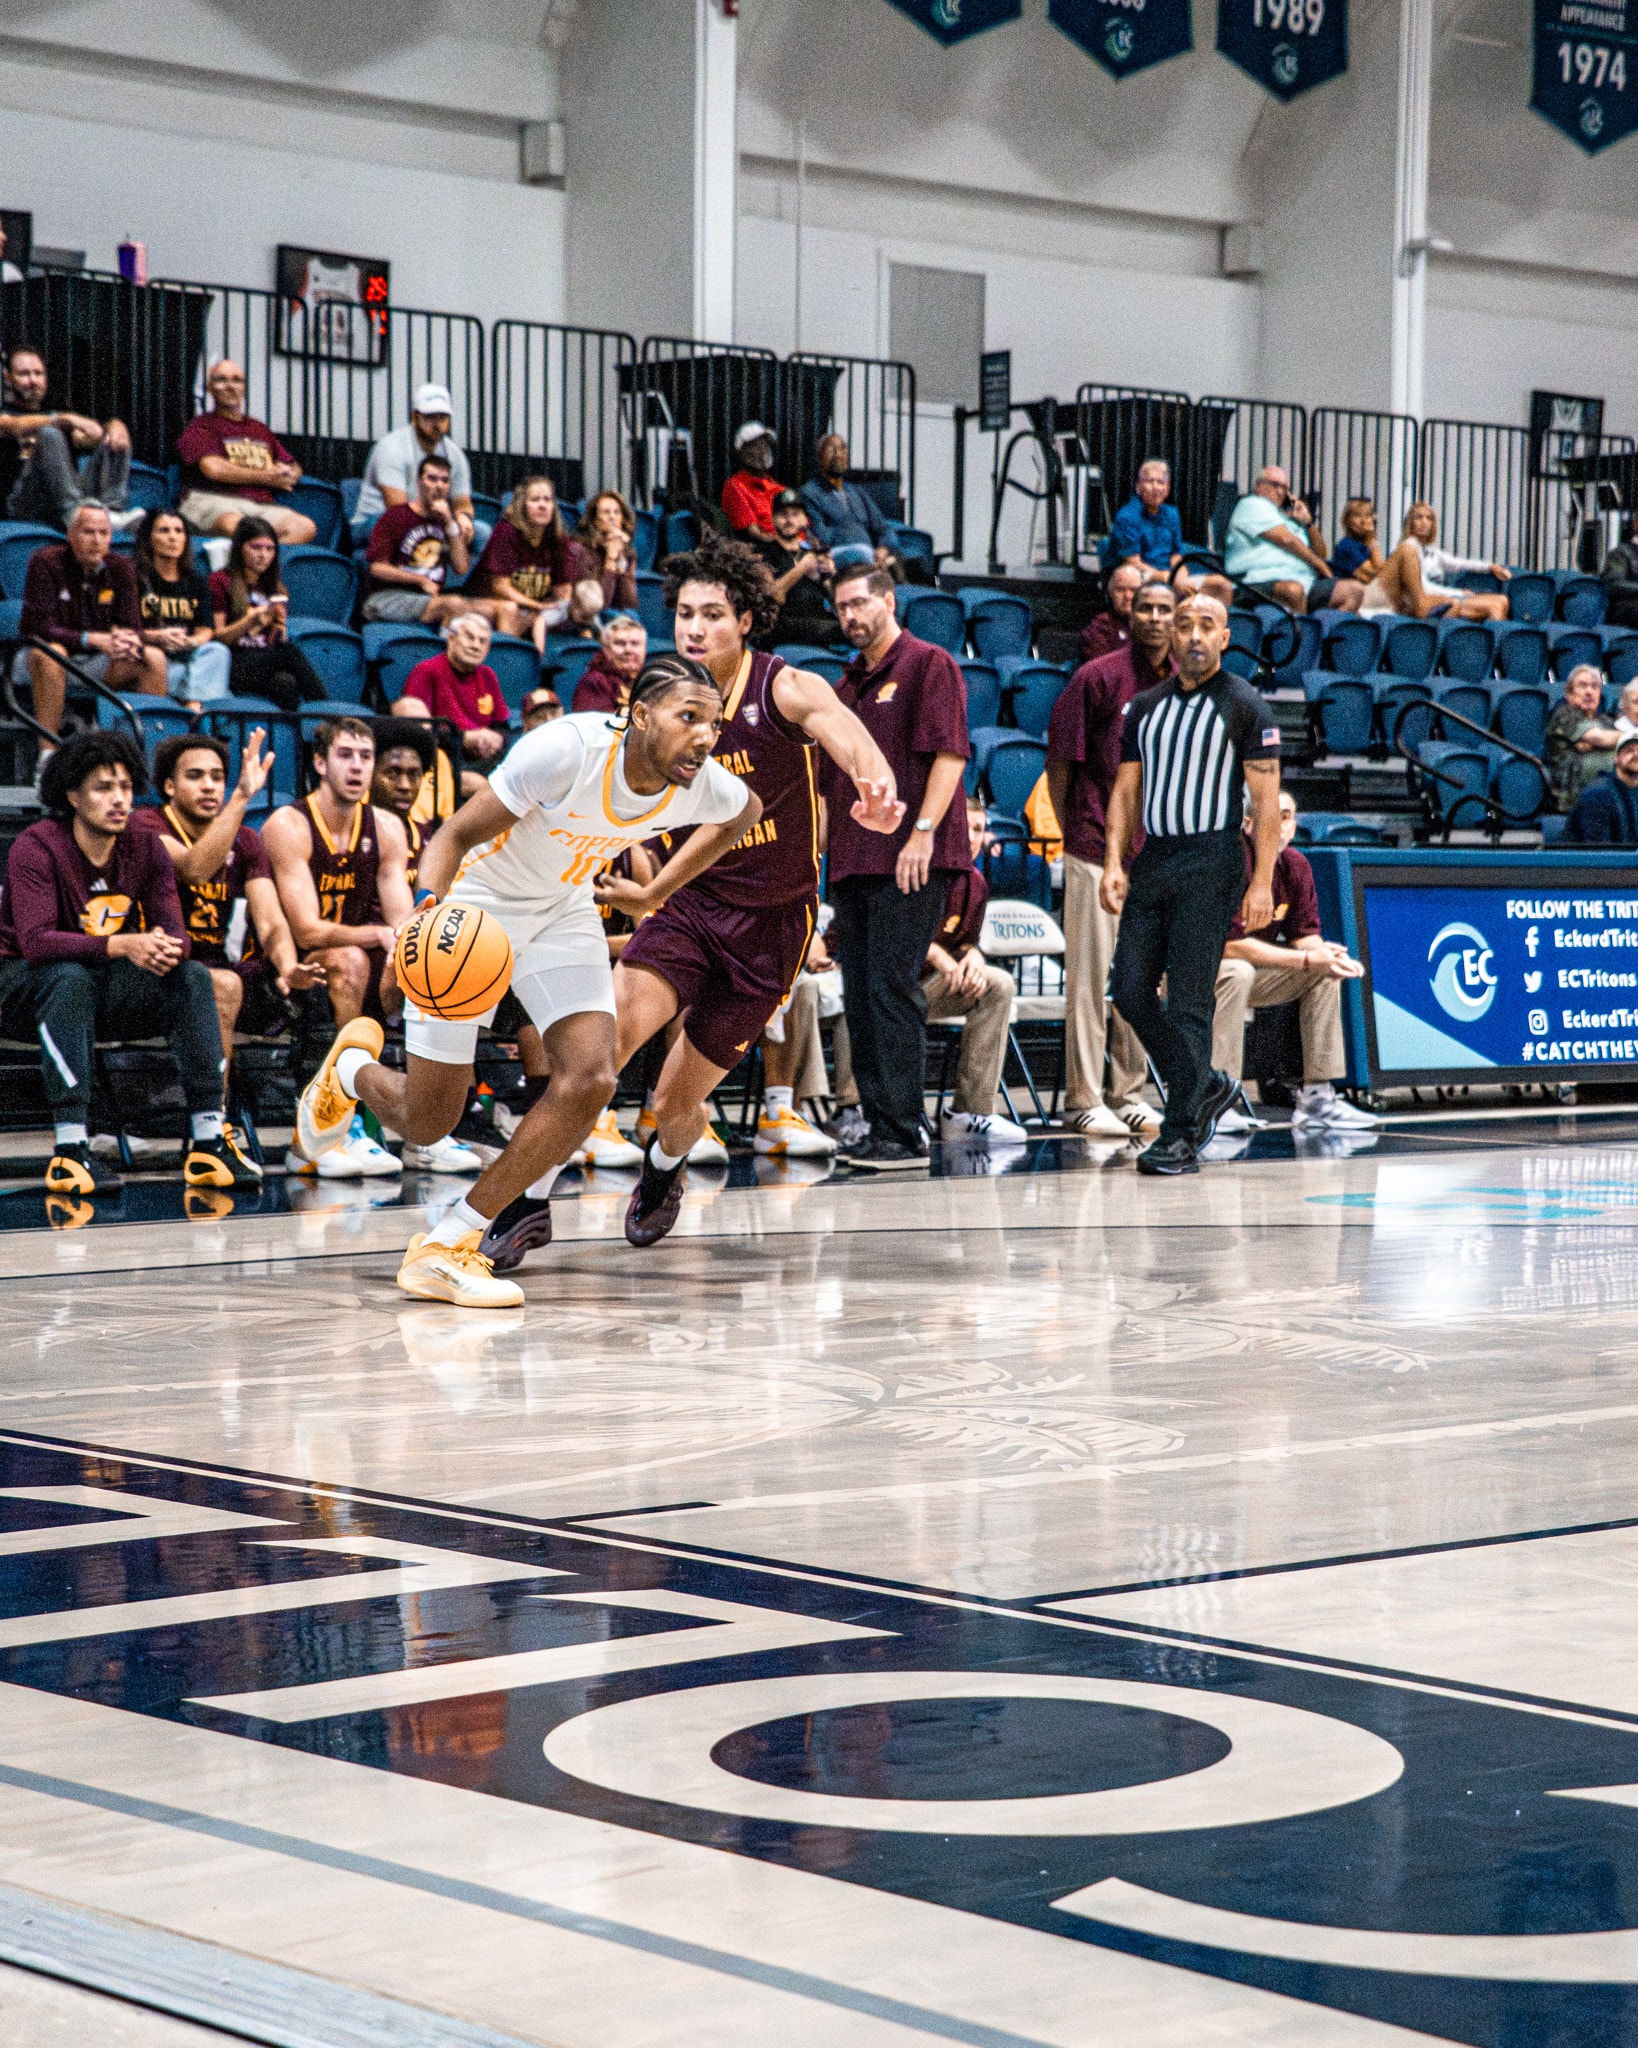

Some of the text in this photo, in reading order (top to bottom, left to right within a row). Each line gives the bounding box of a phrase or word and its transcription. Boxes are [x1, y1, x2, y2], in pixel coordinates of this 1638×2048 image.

[1253, 0, 1324, 36] 1989
[1558, 41, 1625, 92] 1974
[1506, 899, 1570, 919] FOLLOW
[1572, 900, 1604, 919] THE
[437, 908, 466, 955] NCAA
[1462, 949, 1497, 985] EC
[1557, 968, 1637, 988] ECTritons
[1522, 1040, 1638, 1061] #CATCHTHE
